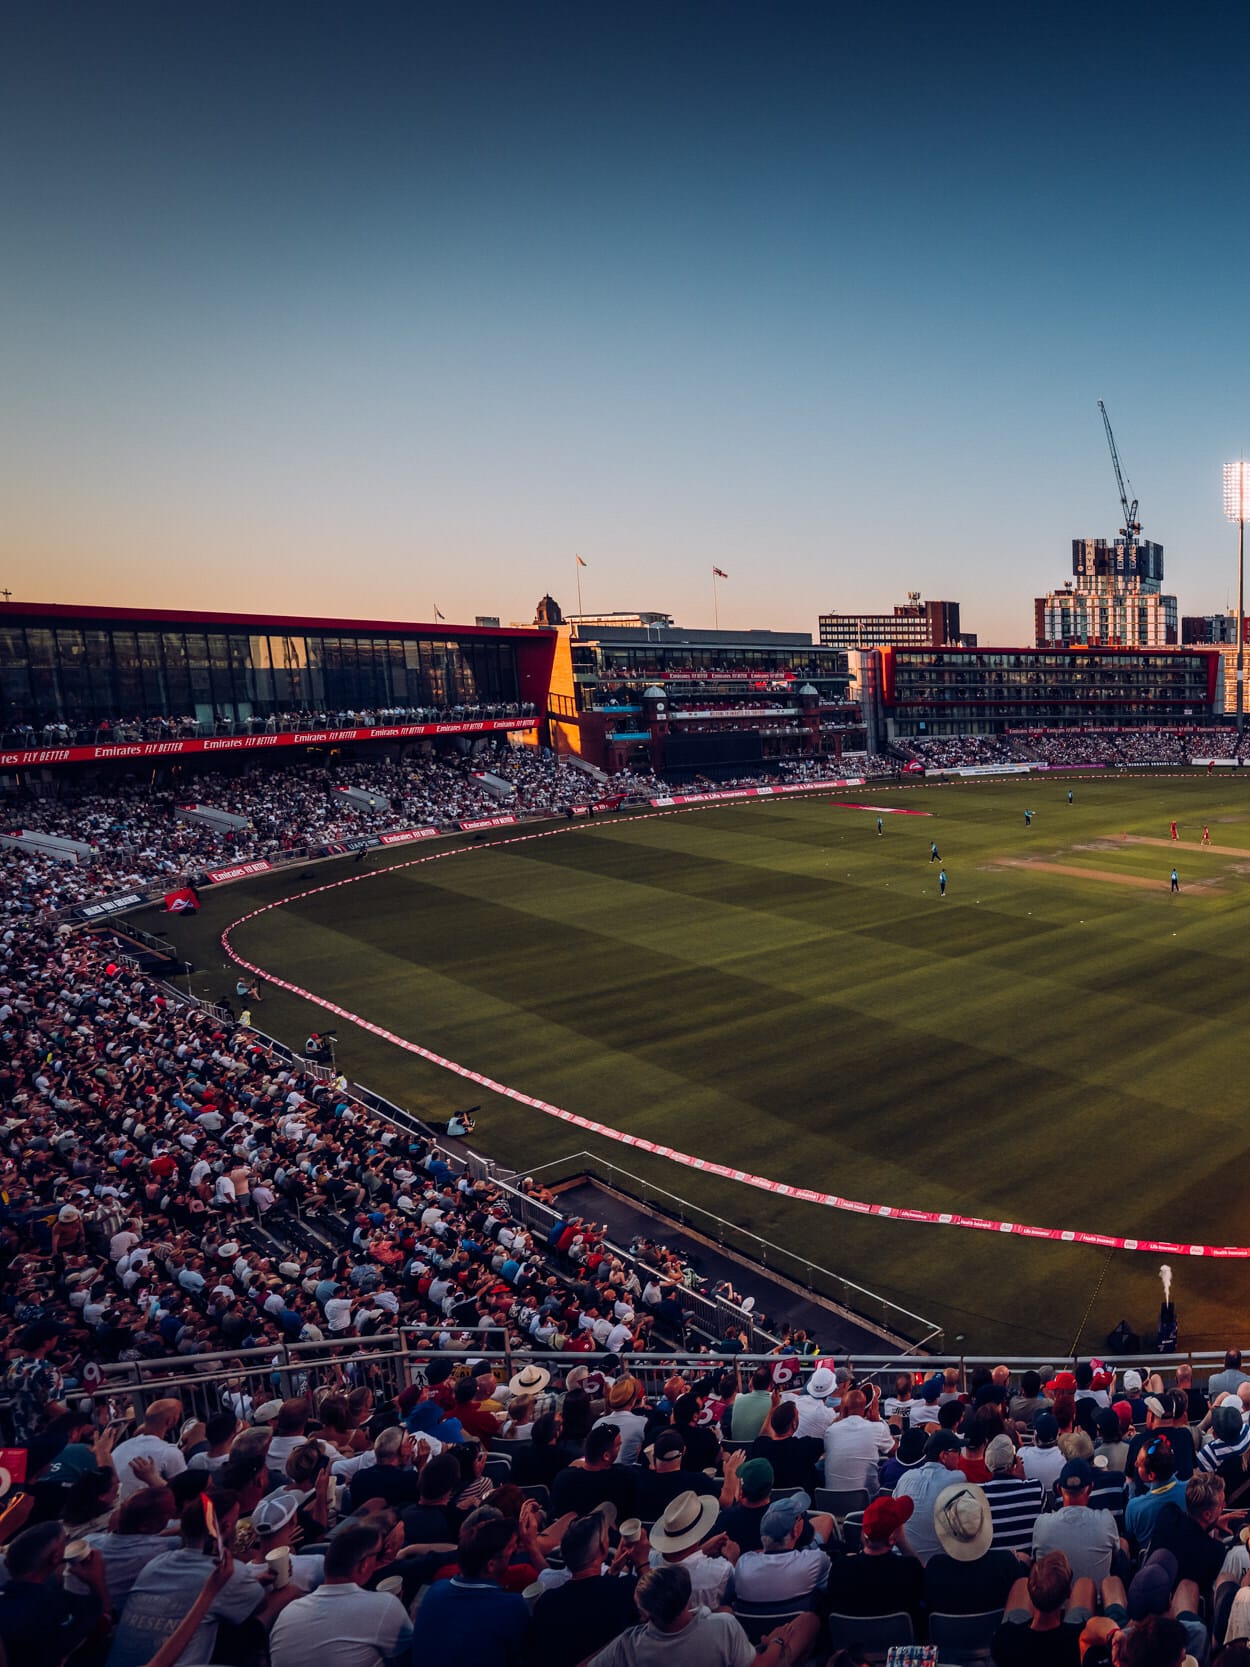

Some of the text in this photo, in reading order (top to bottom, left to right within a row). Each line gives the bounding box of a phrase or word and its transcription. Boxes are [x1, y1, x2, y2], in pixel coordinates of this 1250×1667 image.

[436, 724, 461, 733] Emirates
[493, 720, 515, 729] Emirates
[294, 729, 358, 743] Emirates FLY BETTER
[370, 728, 399, 738] Emirates
[409, 726, 425, 735] BETTER
[203, 735, 278, 750] Emirates FLY BETTER
[22, 751, 39, 763] FLY
[38, 749, 71, 762] BETTER
[94, 742, 184, 758] Emirates FLY BETTER
[684, 794, 701, 802] Health
[709, 791, 721, 800] Life
[721, 790, 748, 799] Insurance
[463, 820, 492, 830] Emirates
[384, 832, 414, 844] Emirates
[212, 867, 246, 883] Emirates
[773, 1362, 793, 1384] 6
